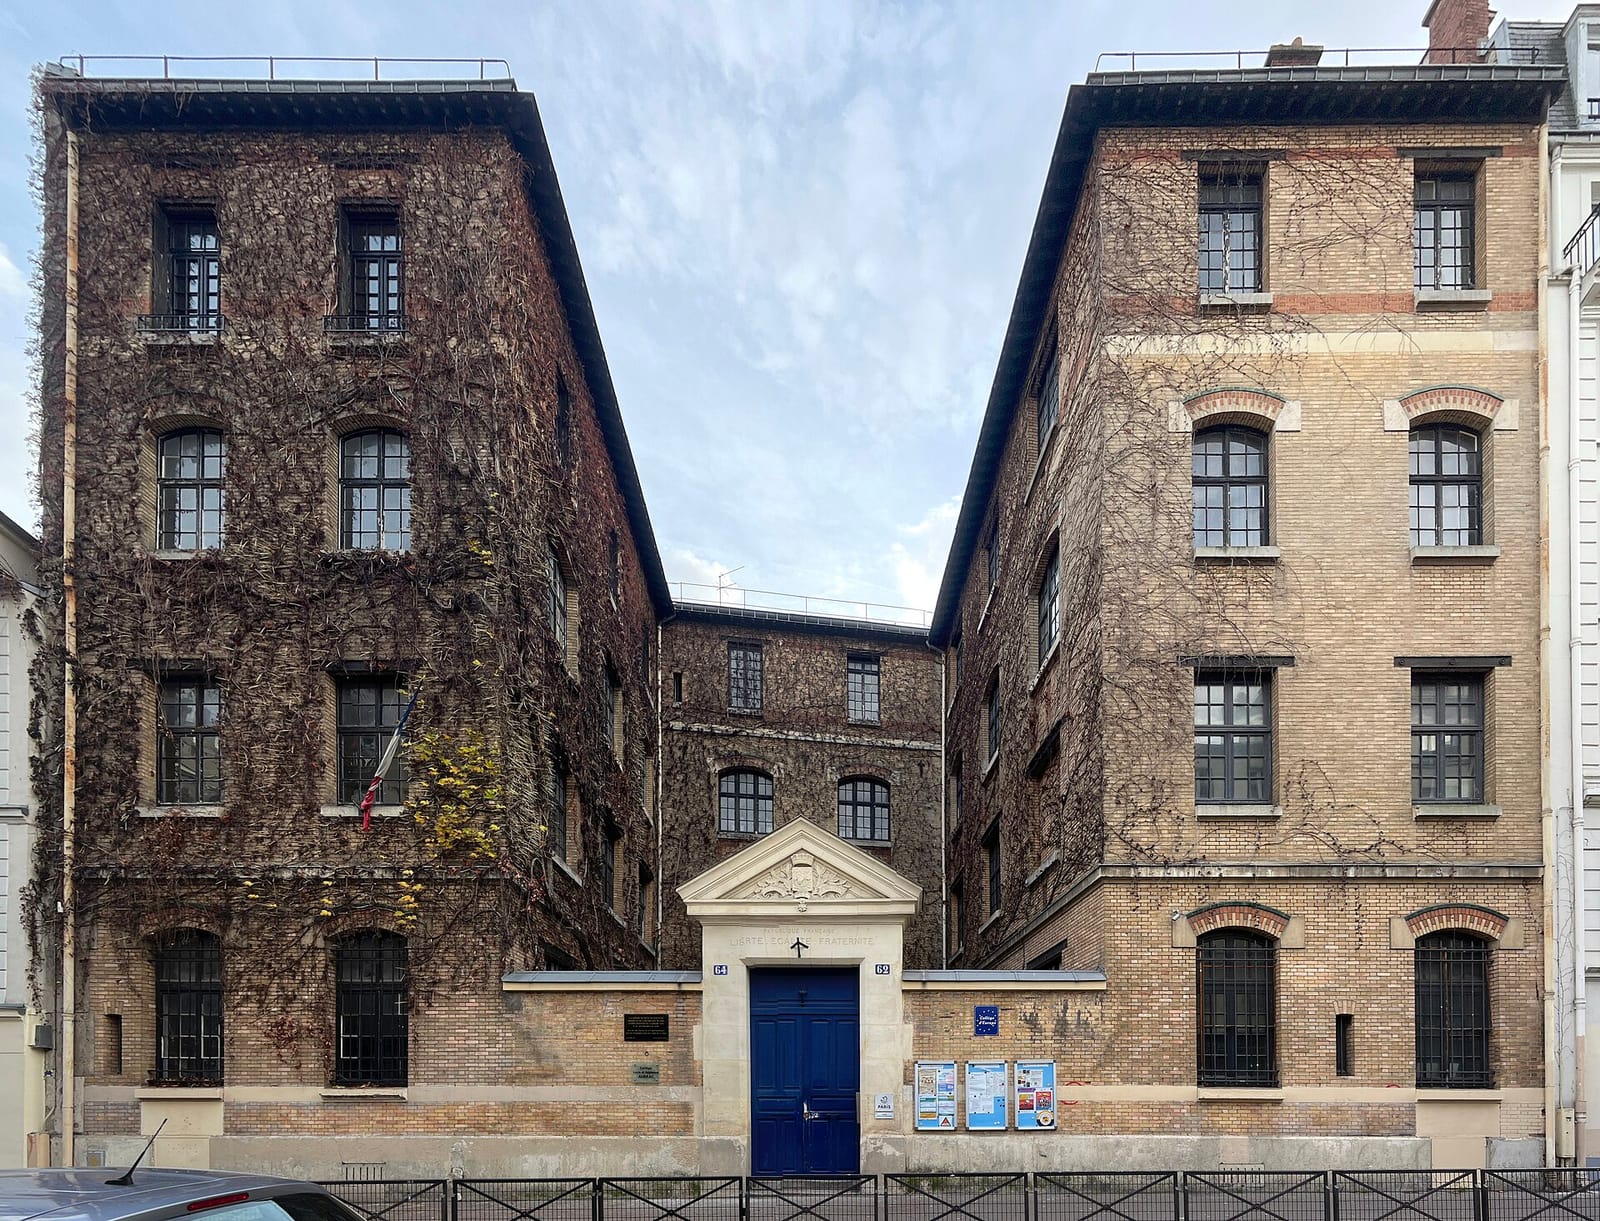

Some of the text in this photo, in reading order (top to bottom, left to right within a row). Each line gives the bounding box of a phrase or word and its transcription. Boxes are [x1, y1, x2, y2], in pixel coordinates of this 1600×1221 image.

[771, 937, 811, 945] EGALTE
[714, 965, 727, 975] 64
[876, 965, 889, 974] 62
